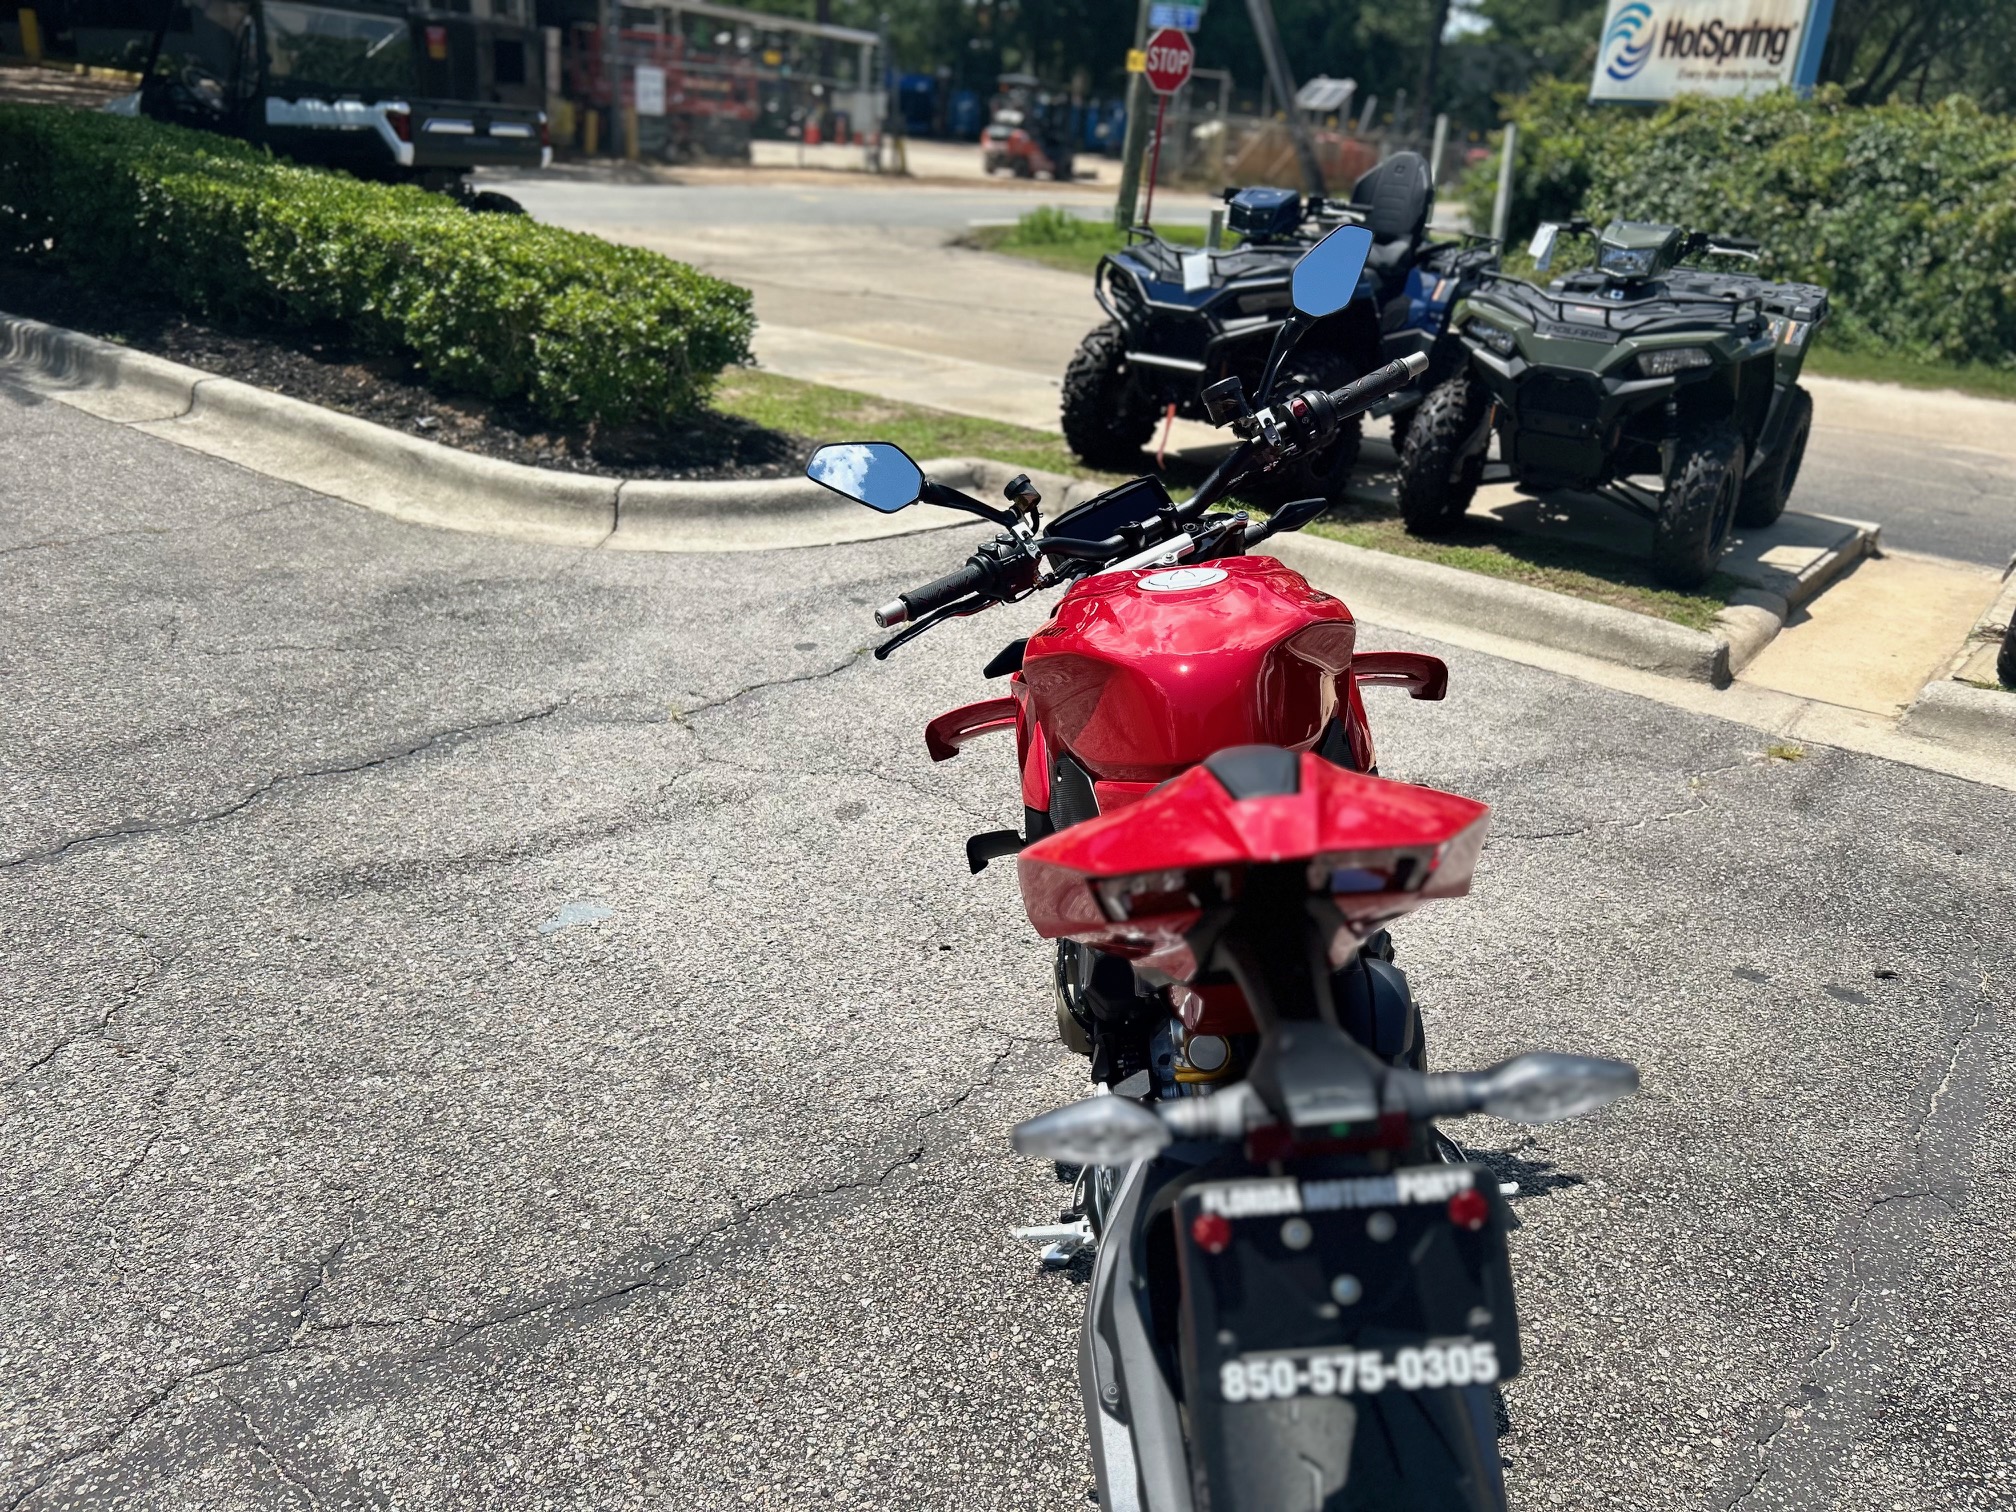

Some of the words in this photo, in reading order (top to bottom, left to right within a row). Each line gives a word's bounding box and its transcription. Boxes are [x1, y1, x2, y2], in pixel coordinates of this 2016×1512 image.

[1660, 18, 1790, 66] HotSpring
[1148, 46, 1190, 75] STOP
[1546, 324, 1608, 340] POLARIS
[1202, 1182, 1301, 1218] FLORIDA
[1220, 1342, 1499, 1402] 850-575-0305
